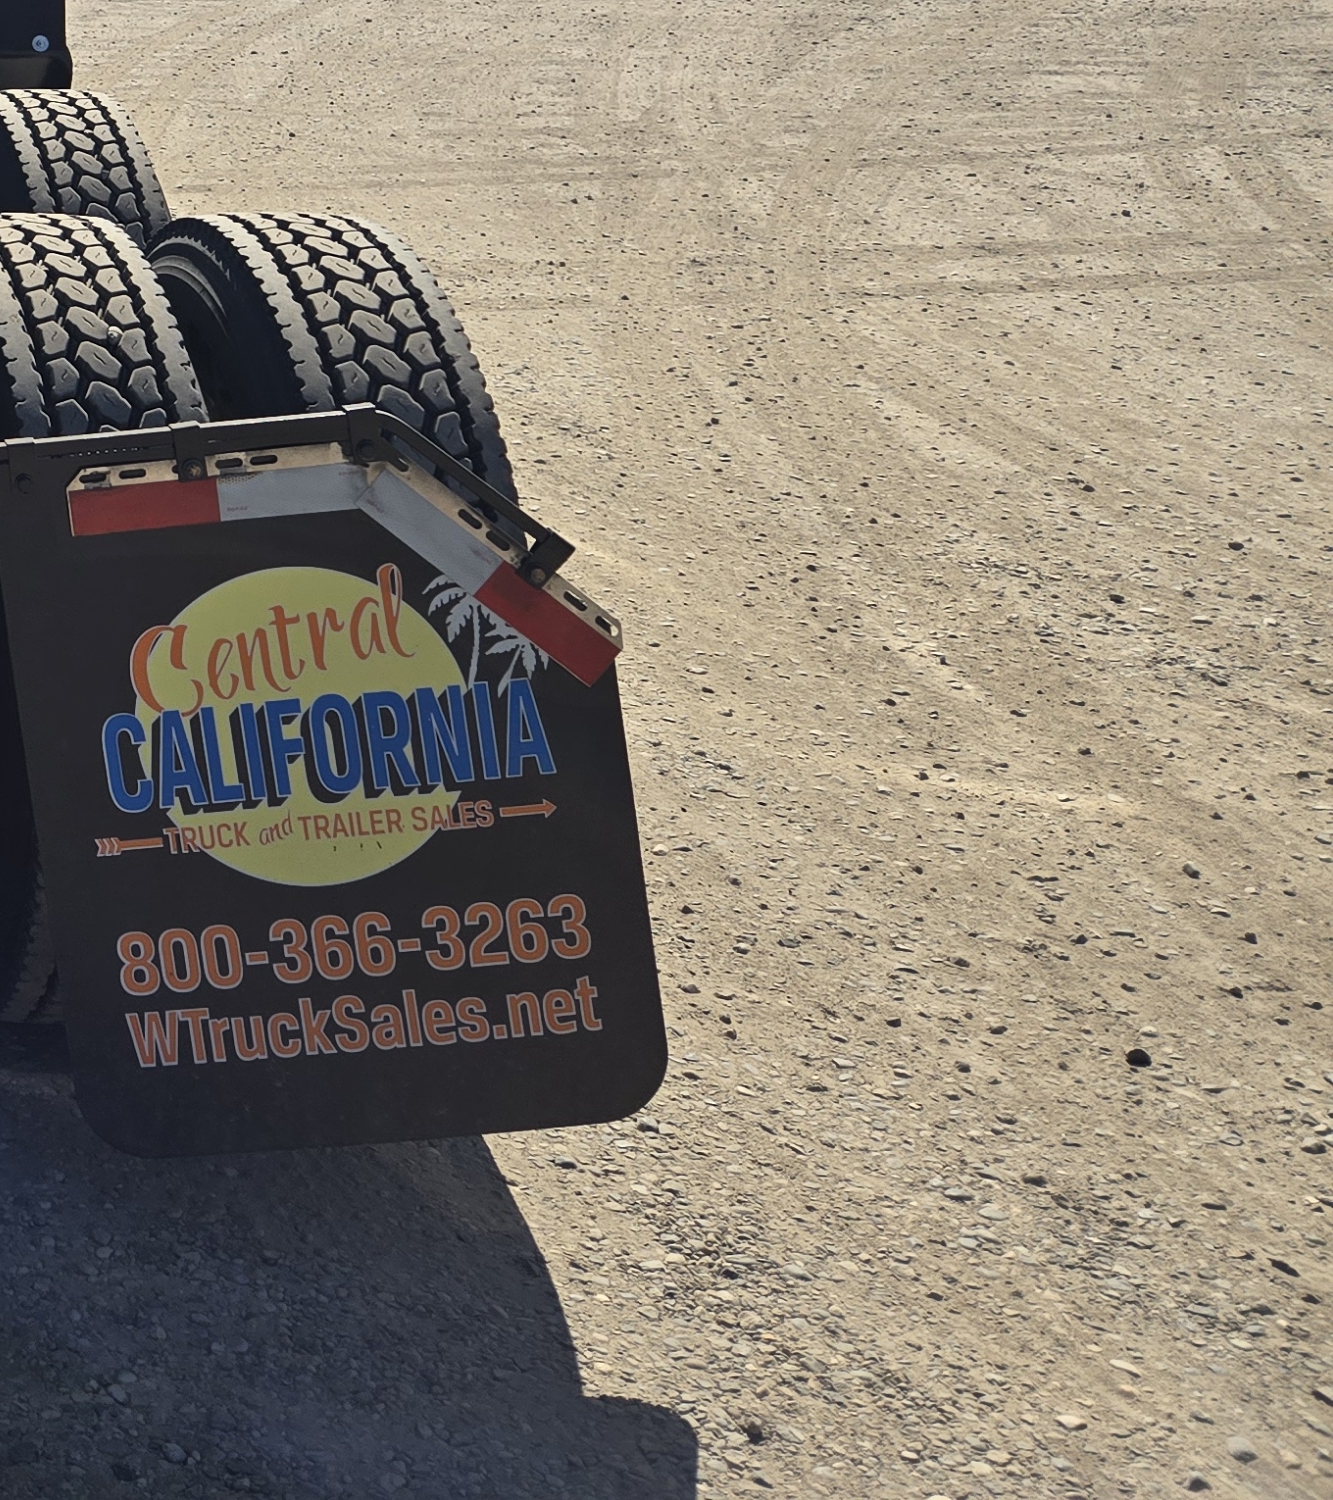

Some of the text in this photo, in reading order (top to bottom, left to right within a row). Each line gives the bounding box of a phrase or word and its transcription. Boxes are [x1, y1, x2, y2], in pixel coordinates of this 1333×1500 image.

[130, 562, 417, 719] Central
[102, 678, 558, 814] CALIFORNIA
[163, 800, 494, 855] TRUCK and TRAILER SALES
[117, 893, 592, 996] 800-366-3263
[126, 976, 603, 1068] WTruckSales.net
